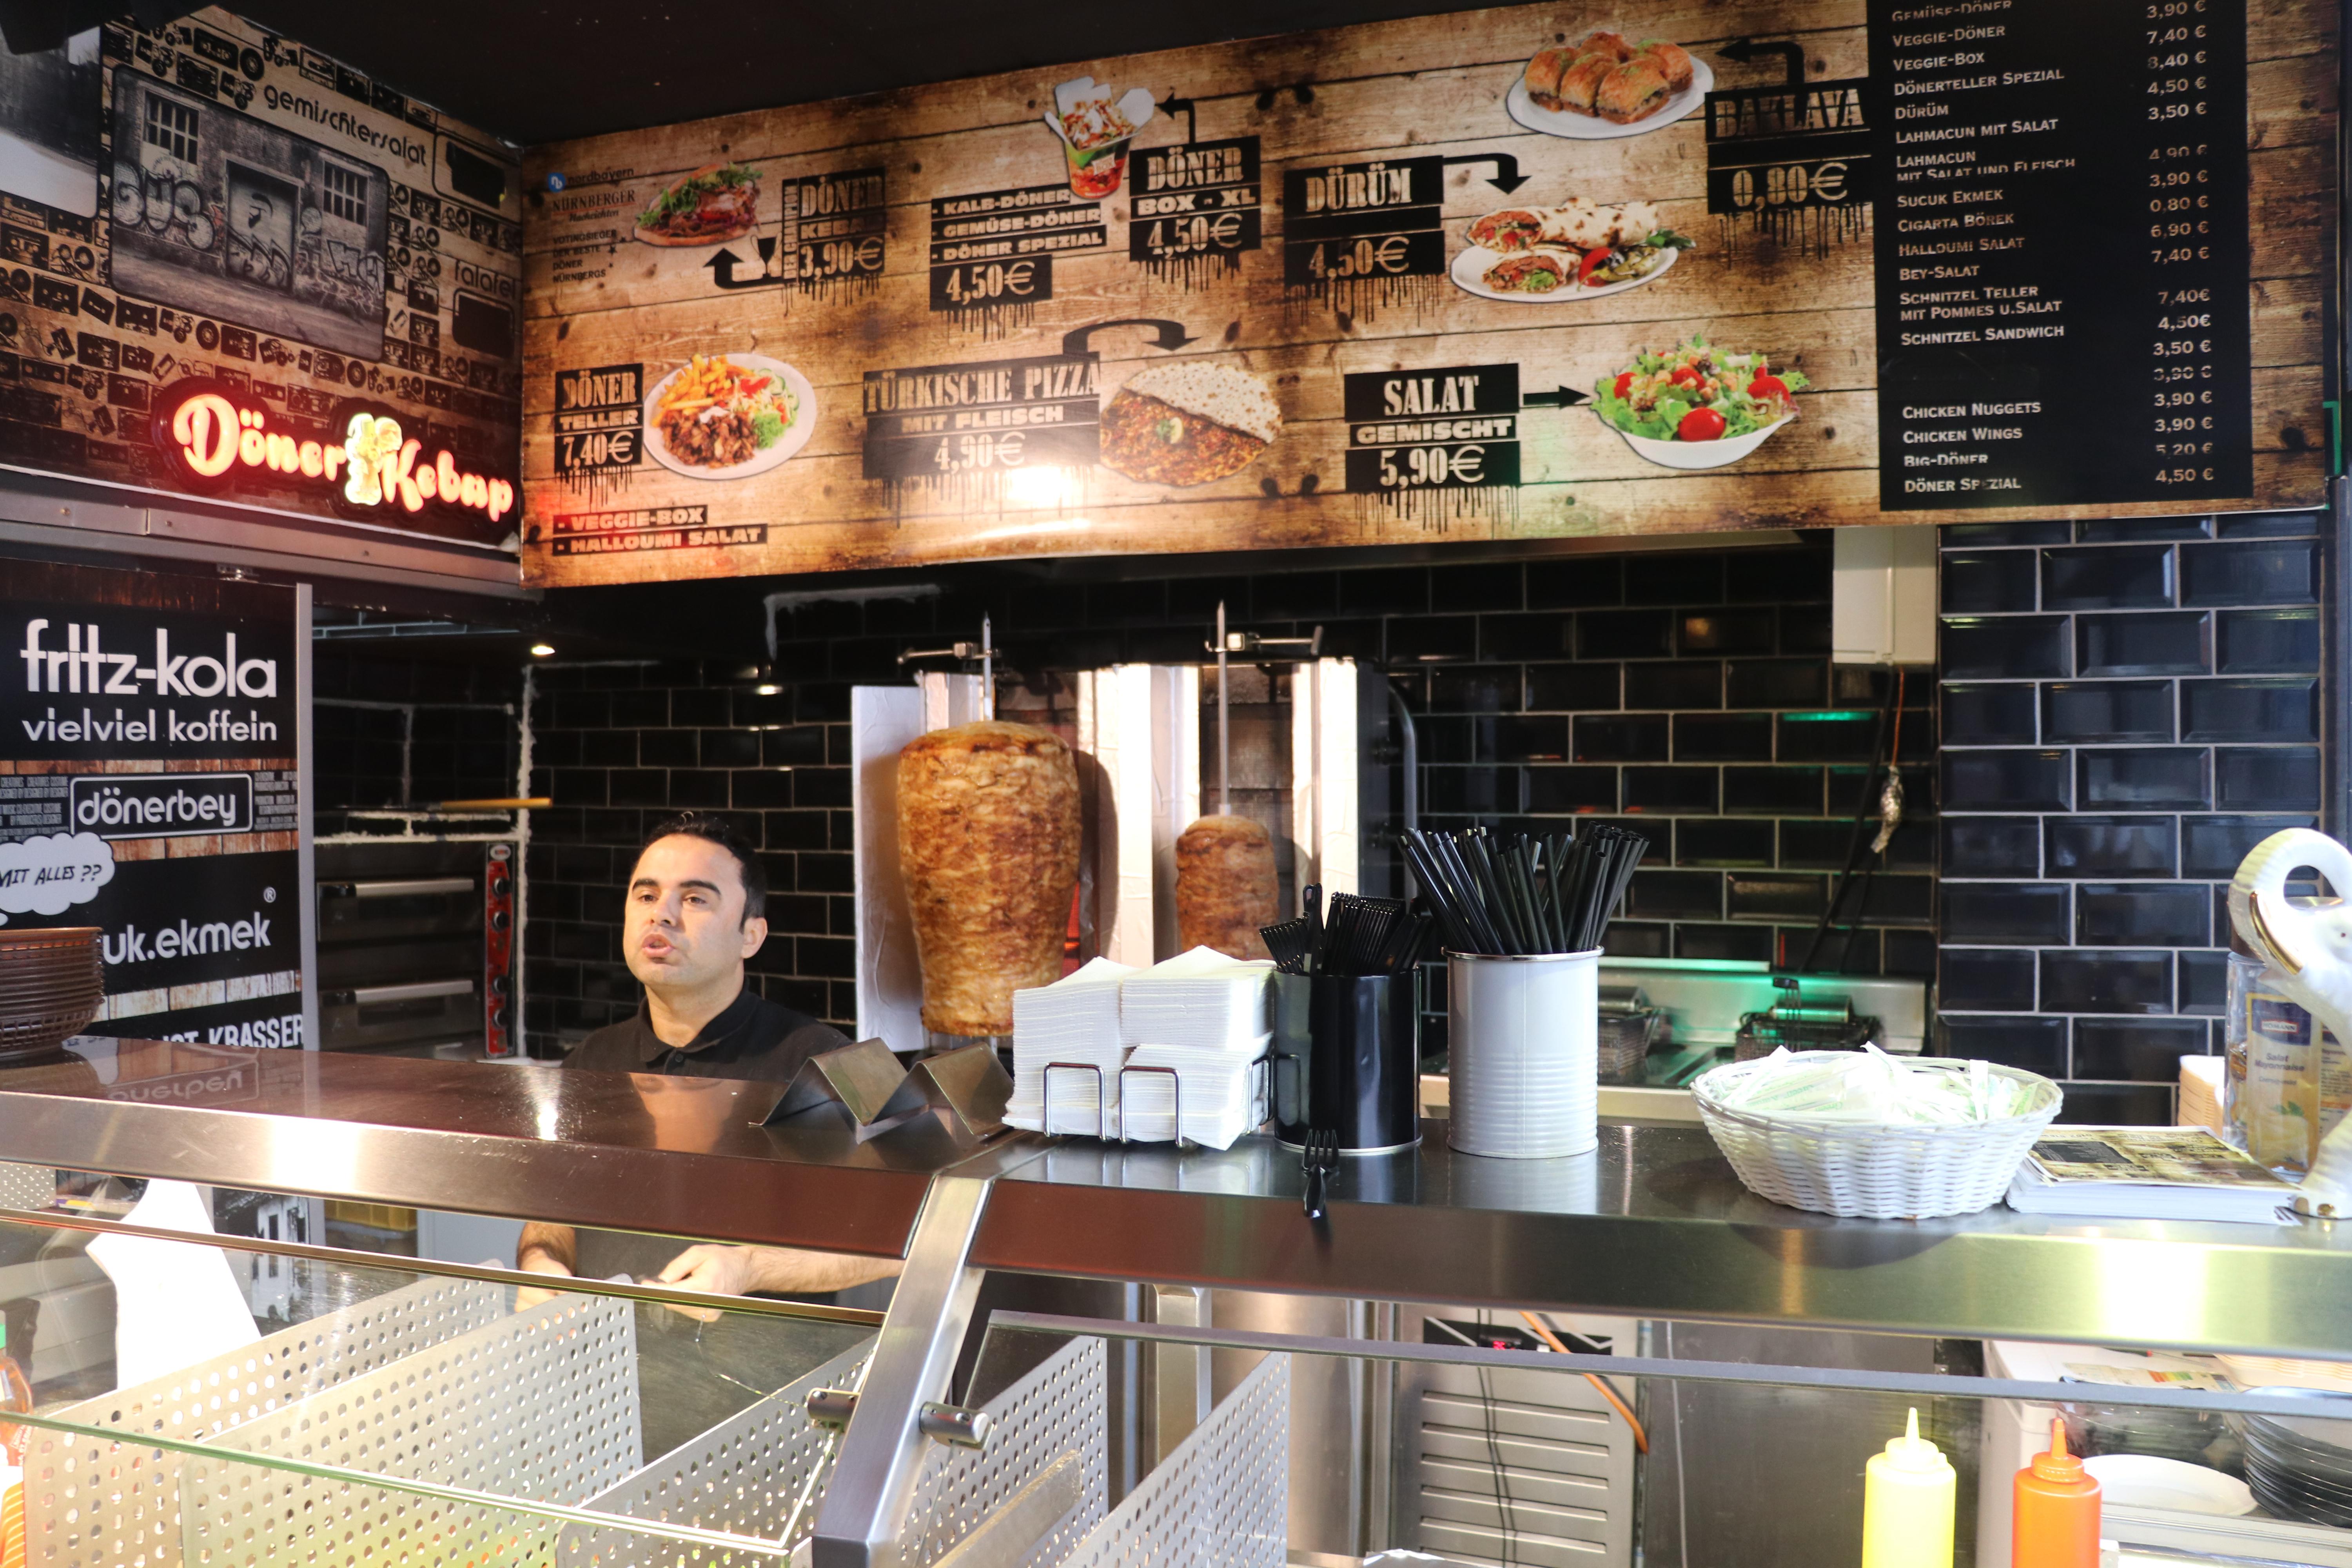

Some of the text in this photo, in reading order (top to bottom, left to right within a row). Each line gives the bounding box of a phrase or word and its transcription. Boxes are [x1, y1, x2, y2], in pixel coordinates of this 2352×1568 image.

[2146, 0, 2207, 20] 3,90 €
[1893, 26, 2005, 47] VEGGIE-DÖNER
[2147, 24, 2207, 45] 7,40 €
[1893, 53, 1985, 71] VEGGIE-BOX
[2194, 50, 2207, 64] €
[1895, 69, 2065, 95] DÖNERTELLER SPEZIAL
[2147, 76, 2207, 96] 4,50 €
[1715, 89, 1864, 137] BAKLAVA
[1895, 103, 1949, 120] DÜRÜM
[2148, 101, 2207, 122] 3,50 €
[263, 85, 426, 166] gemischtersalat
[1896, 119, 2058, 143] LAHMACUN MIT SALAT
[1896, 151, 1976, 168] LAHMACUN
[2149, 146, 2190, 163] 4,90
[568, 168, 633, 183] nordbayern
[1147, 146, 1244, 191] DÖNER
[1897, 172, 1922, 182] MIT
[1306, 163, 1411, 212] DÜRÜM
[1733, 162, 1847, 211] 0,80€
[2149, 170, 2208, 188] 3,90 €
[944, 189, 1070, 215] KALB-DÖNER
[1138, 195, 1194, 216] BOX
[1221, 189, 1256, 208] XL
[1898, 189, 2004, 207] SUCUK EKMEK
[2150, 195, 2209, 213] 0,80 €
[944, 208, 1101, 238] GEMÜSE-DÖNER
[1898, 212, 2014, 232] CIGARTA BÖREK
[2151, 221, 2209, 239] 6,90 €
[1148, 212, 1242, 260] 4,50€
[944, 232, 1103, 261] DÖNER SPEZIAL
[1899, 237, 2025, 256] HALLOUMI SALAT
[2151, 247, 2210, 264] 7,40 €
[553, 259, 583, 270] DÖNER
[800, 236, 883, 281] 3,90€
[1309, 236, 1409, 282] 4,50€
[455, 260, 515, 299] falafel
[1900, 265, 1980, 281] BEY-SALAT
[946, 261, 1036, 306] 4,50€
[1900, 286, 2038, 305] SCHNITZEL TELLER
[2158, 289, 2210, 306] 7,40€
[1901, 309, 1926, 321] MIT
[1931, 305, 1994, 319] POMMES
[2158, 314, 2211, 331] 4,50€
[1901, 326, 2065, 346] SCHNITZEL SANDWICH
[2153, 340, 2211, 357] 3,50 €
[562, 369, 637, 410] DÖNER
[865, 362, 1101, 413] TÜRKISCHE PIZZA
[1384, 376, 1479, 416] SALAT
[2154, 391, 2212, 408] 3,90 €
[560, 410, 638, 430] TELLER
[902, 406, 1063, 433] MIT FLEISCH
[1903, 401, 2041, 419] CHICKEN NUGGETS
[1356, 419, 1512, 444] GEMISCHT
[2155, 417, 2213, 433] 3,90 €
[173, 394, 347, 481] Döner
[1903, 427, 2022, 444] CHICKEN WINGS
[564, 430, 633, 470] 7,40€
[935, 431, 1025, 474] 4,90€
[2202, 443, 2213, 455] €
[1380, 445, 1485, 490] 5,90€
[2156, 468, 2214, 485] 4,50 €
[381, 439, 513, 522] Kebap
[1905, 477, 1955, 493] DÖNER
[572, 506, 704, 531] VEGGIE-BOX
[572, 528, 761, 553] HALLOUMI SALAT
[22, 619, 277, 698] fritz-kola
[22, 708, 277, 742] vielviel koffein
[78, 787, 236, 827] dönerbey
[34, 866, 75, 886] ALLES
[2266, 1053, 2288, 1062] Salat
